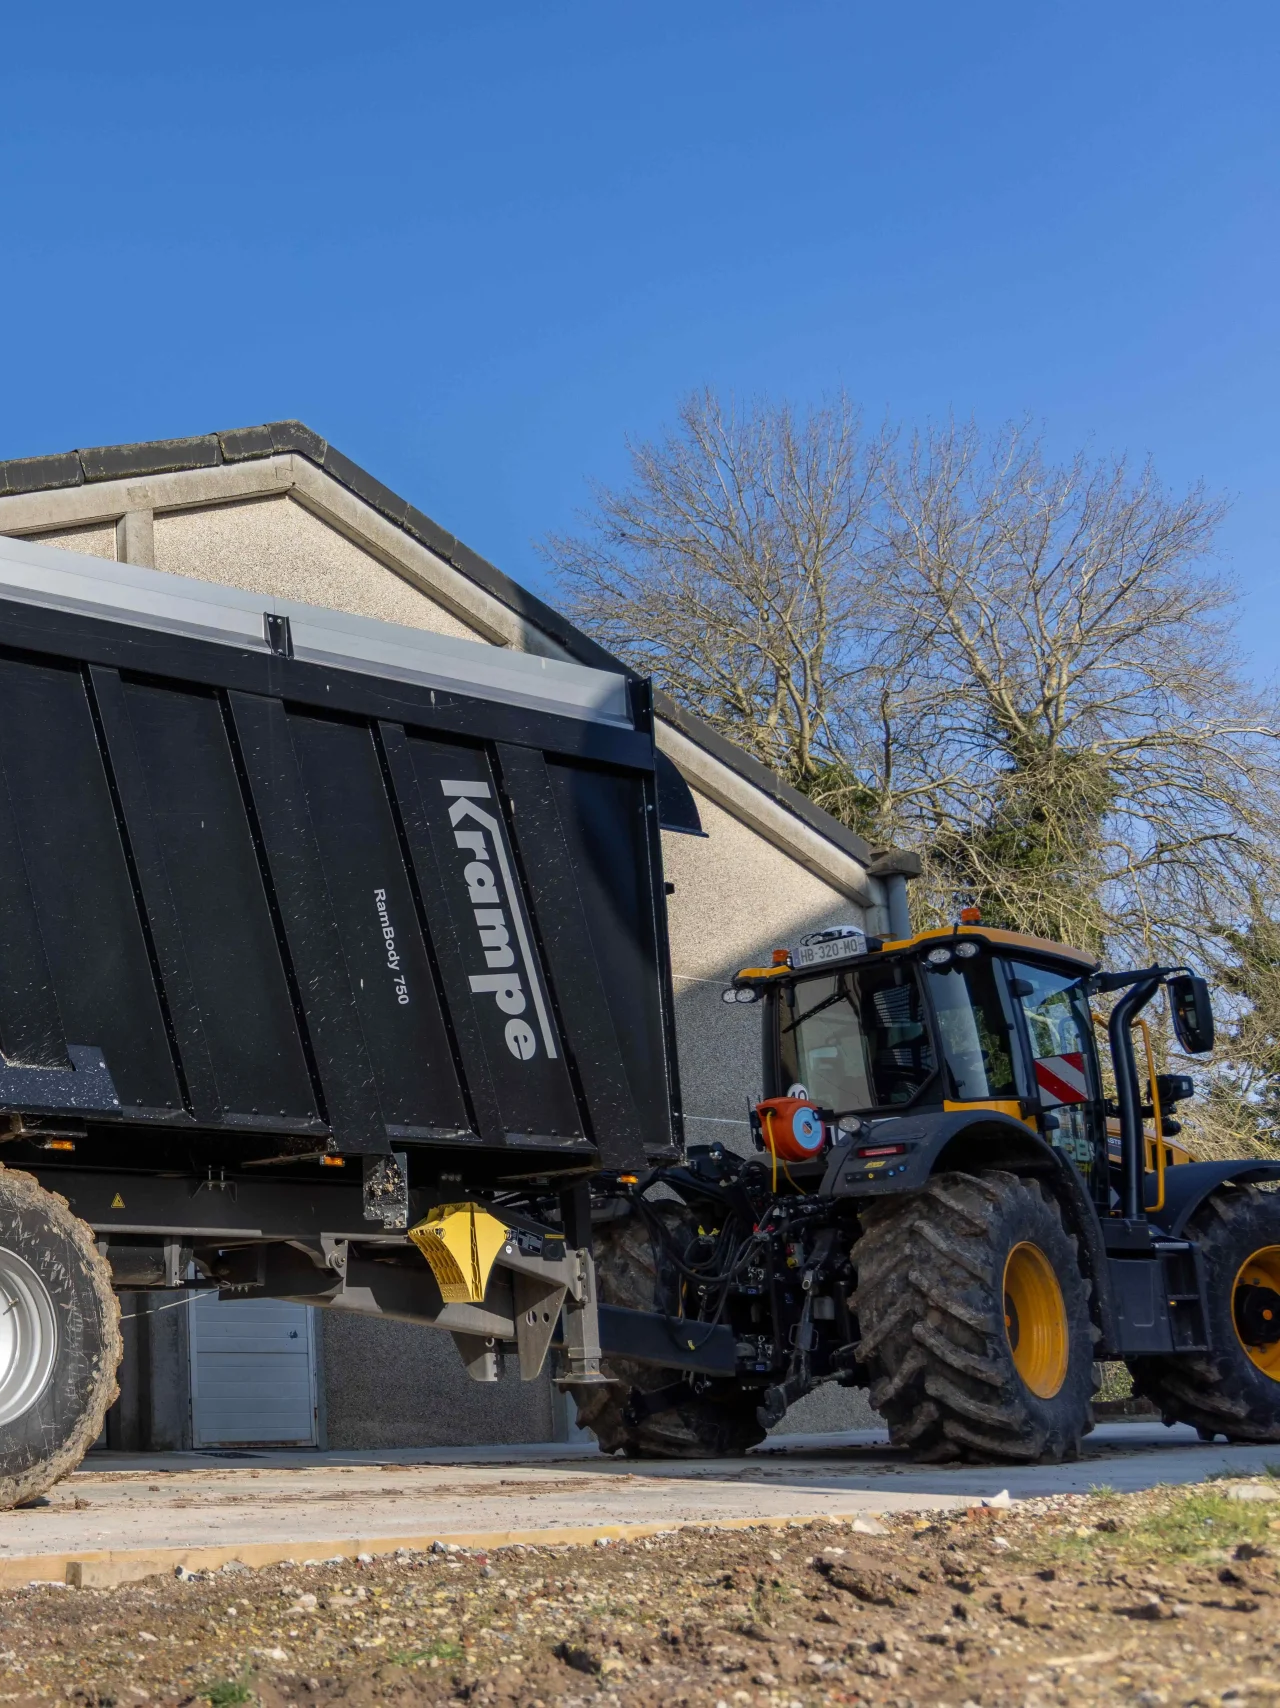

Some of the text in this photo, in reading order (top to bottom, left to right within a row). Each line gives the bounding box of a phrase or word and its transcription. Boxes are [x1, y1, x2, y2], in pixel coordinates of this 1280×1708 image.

[373, 888, 410, 1005] RamBody 750
[440, 779, 557, 1061] Krampe
[800, 939, 858, 964] HB-320-MQ
